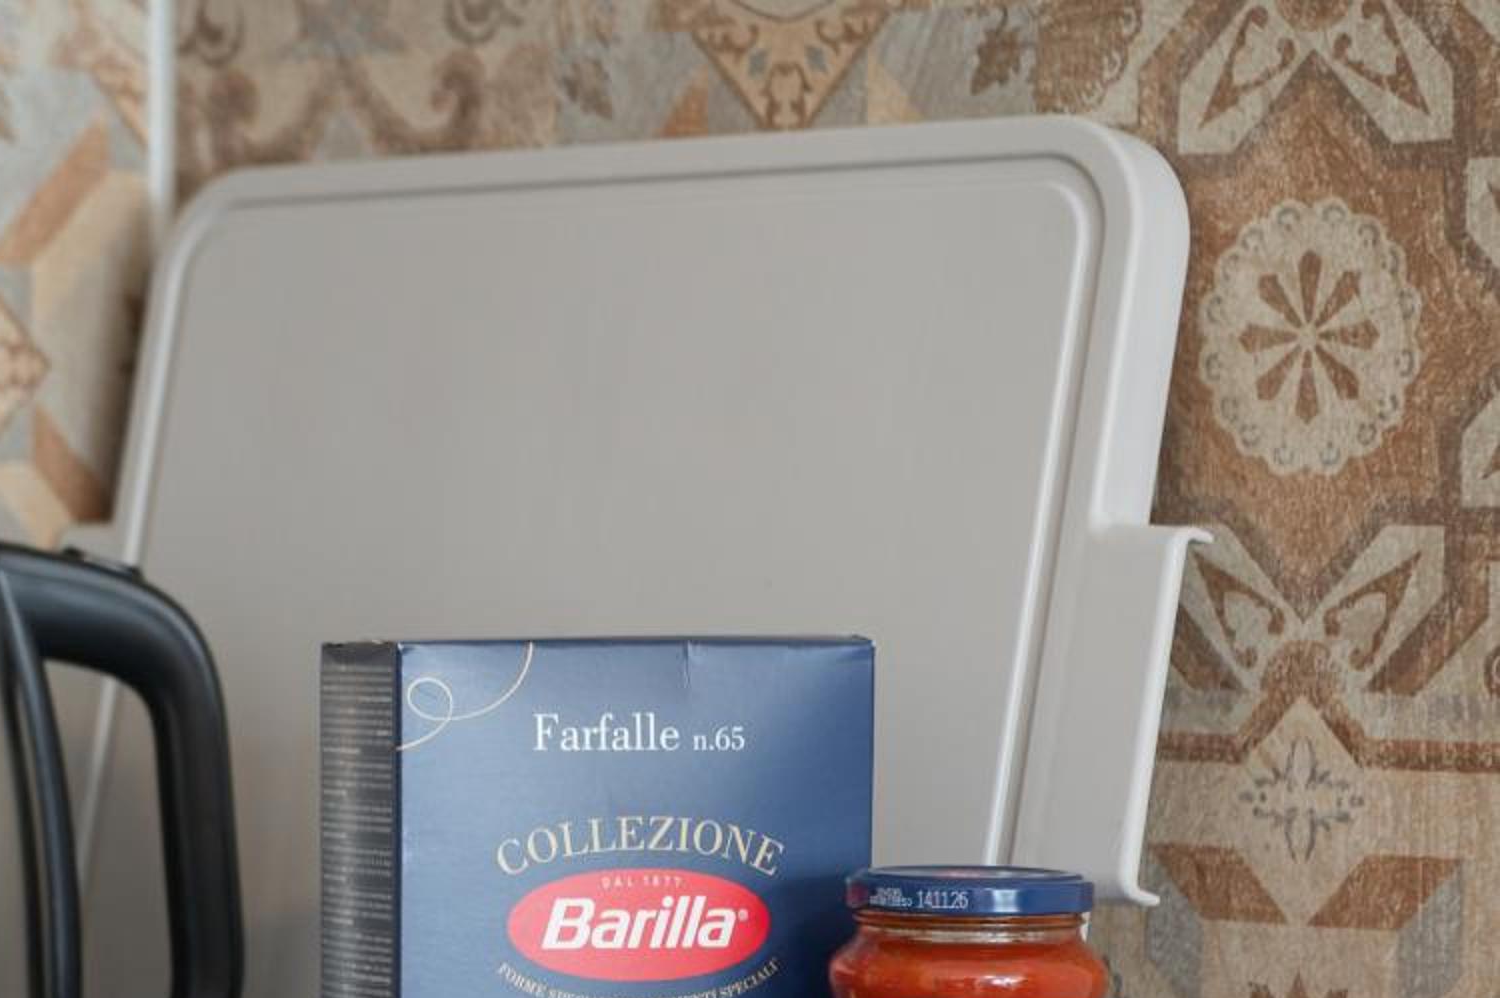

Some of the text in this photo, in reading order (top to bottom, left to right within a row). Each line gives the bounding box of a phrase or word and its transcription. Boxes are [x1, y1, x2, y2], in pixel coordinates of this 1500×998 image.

[532, 711, 746, 751] Farfalle n.65
[496, 815, 785, 876] COLLEZIONE
[541, 895, 736, 950] Barilla
